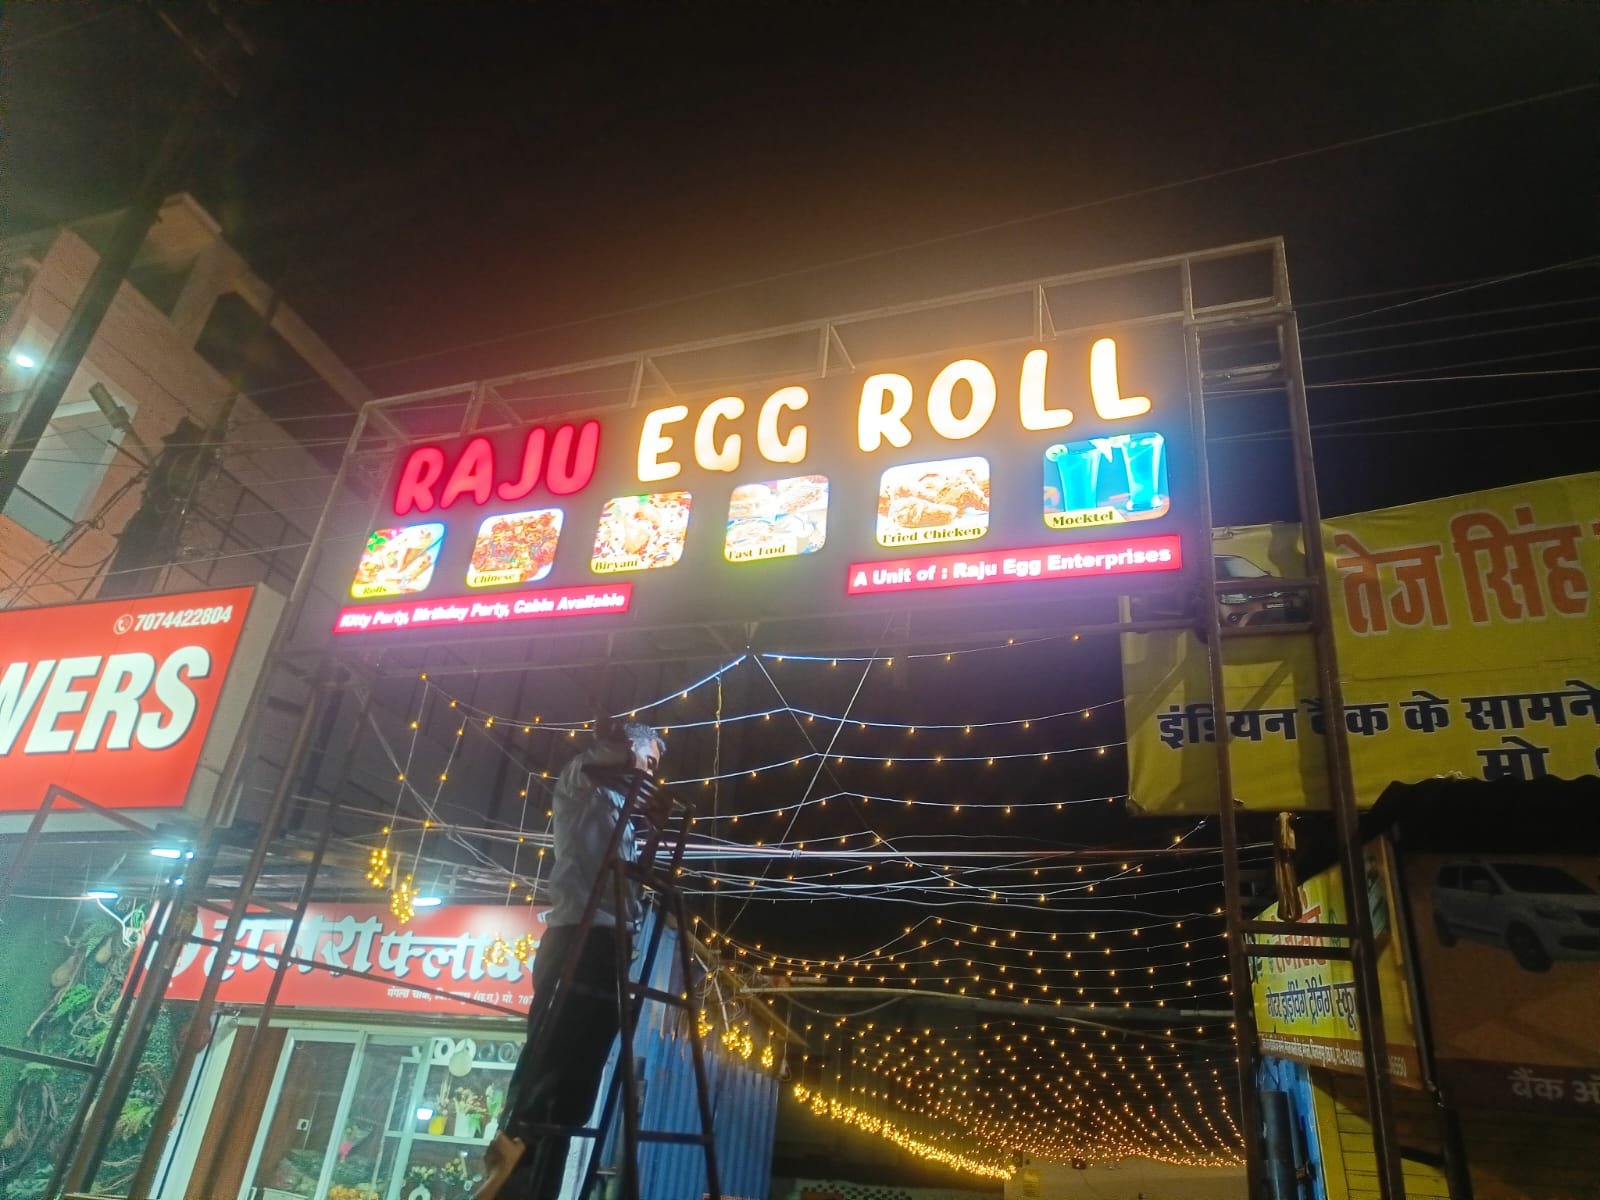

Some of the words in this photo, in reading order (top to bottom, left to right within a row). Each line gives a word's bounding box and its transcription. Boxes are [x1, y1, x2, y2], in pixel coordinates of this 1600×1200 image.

[393, 420, 600, 515] RAJU
[637, 386, 808, 481] EGG
[857, 338, 1151, 452] ROLL
[882, 528, 918, 543] Fried
[923, 525, 982, 540] Chicken
[729, 549, 753, 560] Fast
[757, 543, 786, 557] Food
[473, 573, 515, 585] Chinese
[594, 558, 639, 574] Biryani
[853, 571, 867, 587] A
[872, 567, 911, 586] Unit
[916, 566, 936, 582] of
[953, 560, 997, 580] Raju
[1003, 556, 1041, 577] Egg
[1048, 547, 1171, 571] Enterprises
[1335, 533, 1448, 632] तेज
[1451, 506, 1589, 623] सिंह
[362, 585, 387, 595] Rolls
[134, 605, 233, 632] 7074422804
[339, 613, 372, 630] Kitty
[372, 610, 410, 628] Party,
[412, 604, 470, 623] Birthday
[470, 602, 510, 618] Party,
[514, 598, 553, 614] Cabin
[556, 592, 625, 611] Available
[1400, 690, 1448, 733] के
[1461, 679, 1600, 730] सामने
